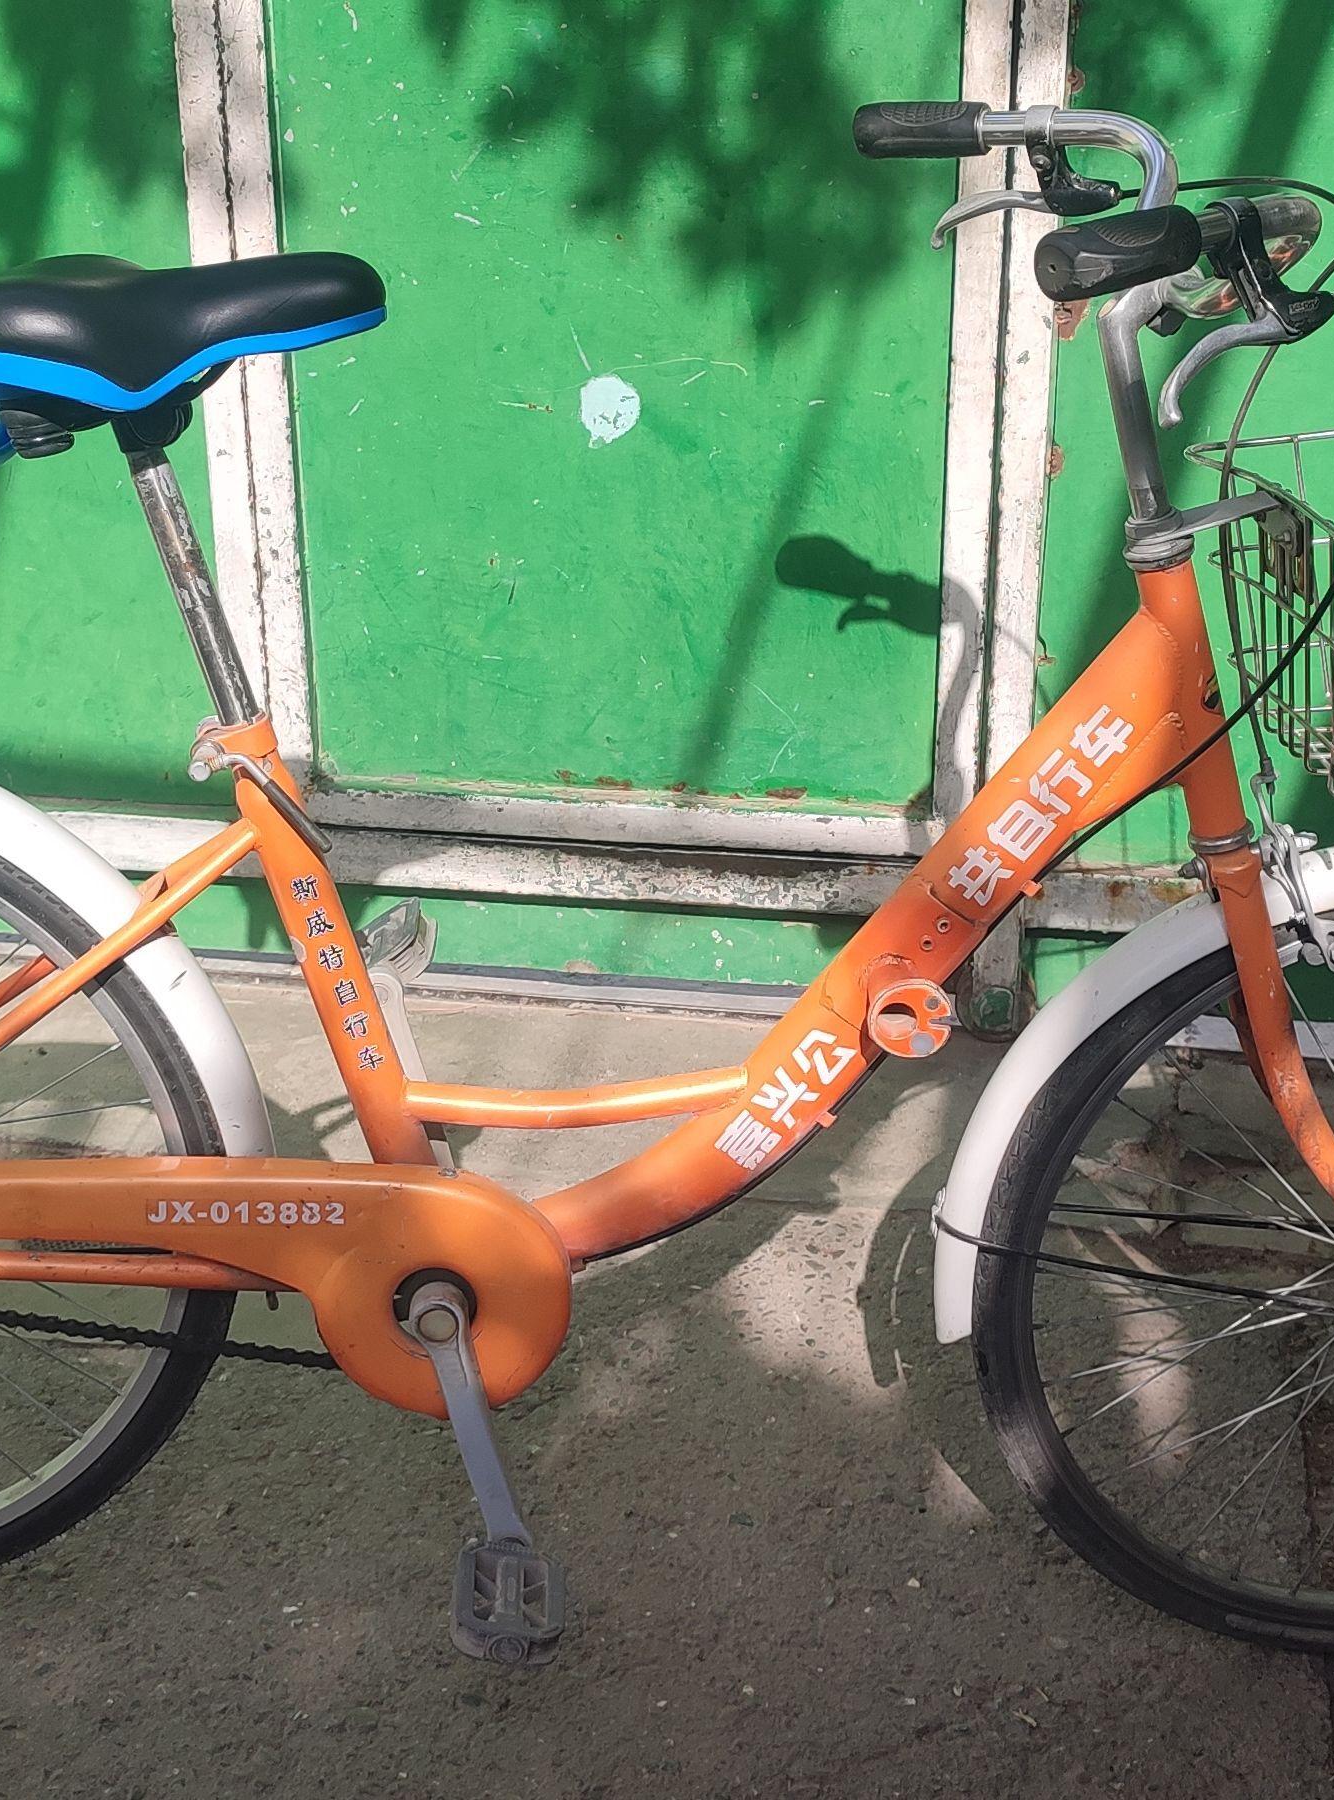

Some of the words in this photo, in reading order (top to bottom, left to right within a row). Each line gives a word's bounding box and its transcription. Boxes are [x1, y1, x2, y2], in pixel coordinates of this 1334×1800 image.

[290, 875, 385, 1070] 斯威特自行车
[147, 1200, 345, 1225] JX-013882
